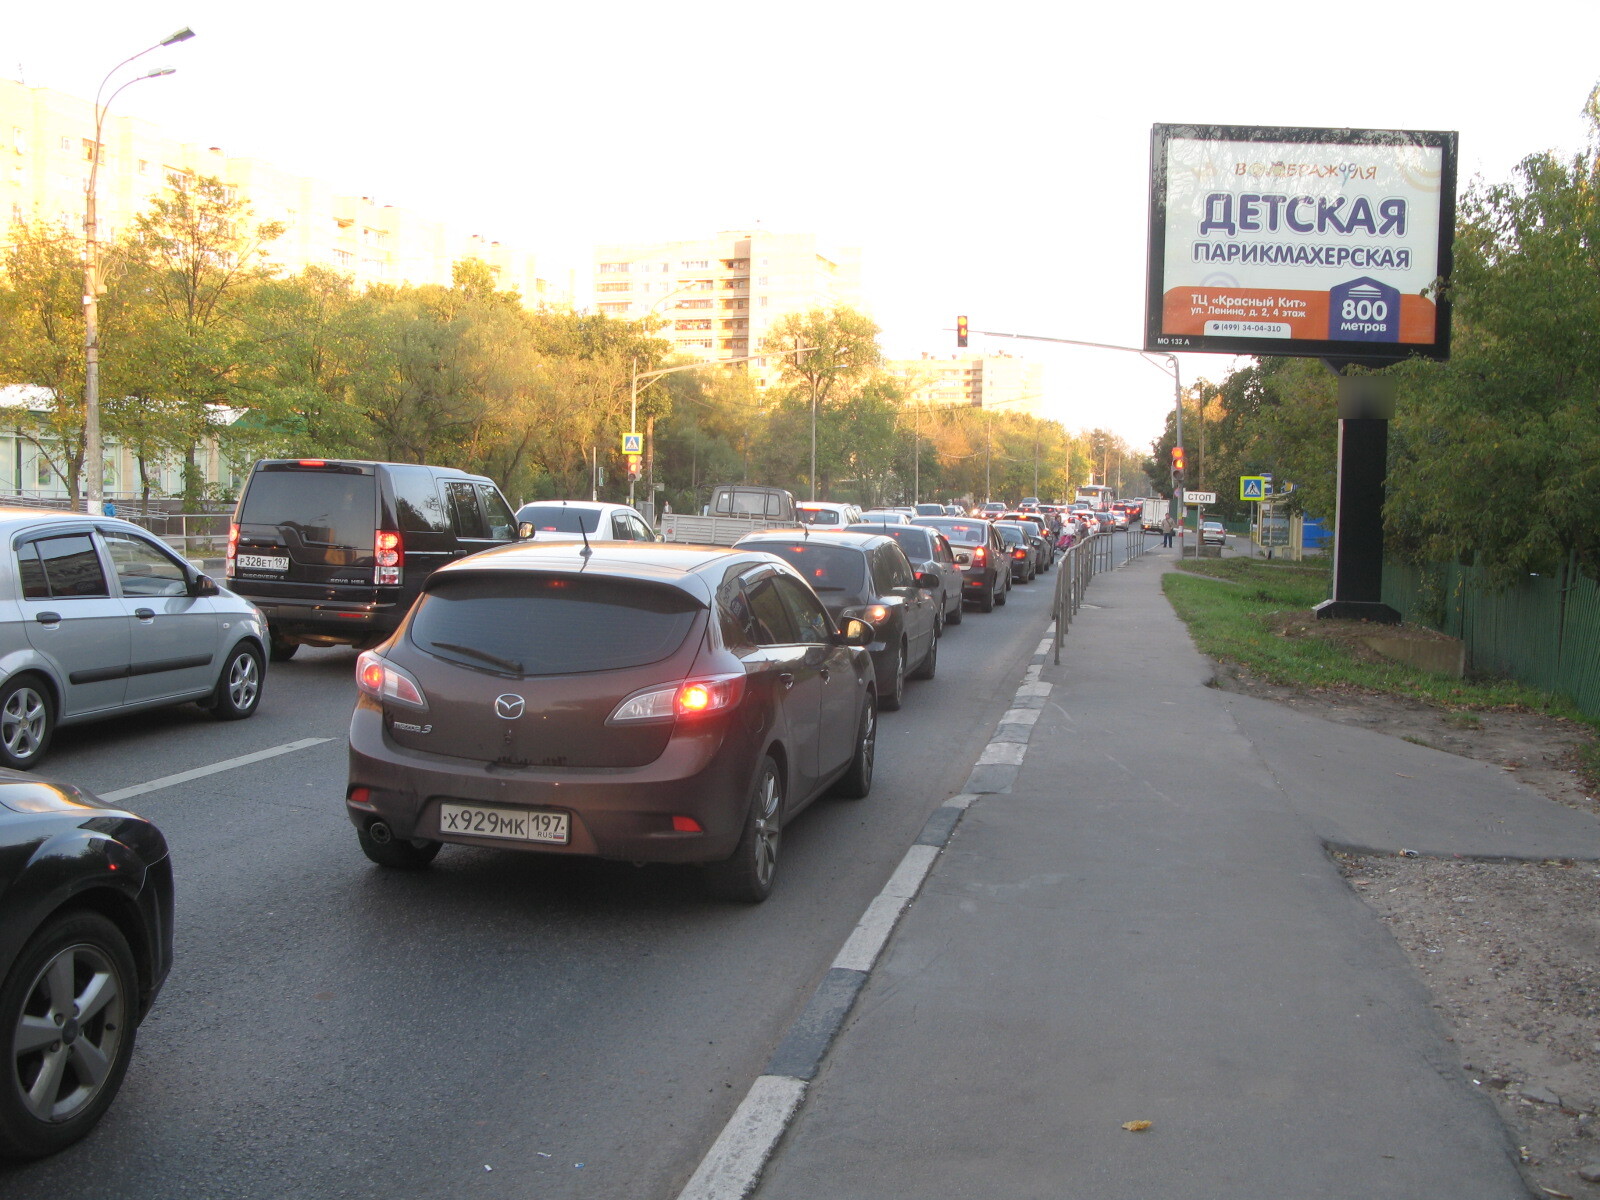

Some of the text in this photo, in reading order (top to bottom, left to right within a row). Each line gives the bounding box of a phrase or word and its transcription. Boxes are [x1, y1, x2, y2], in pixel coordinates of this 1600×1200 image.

[1200, 193, 1406, 236] ДЕТСКАЯ
[1194, 242, 1410, 268] ПАРИКМАХЕРСКАЯ
[1191, 294, 1306, 308] ТЦ «Красный Кит»
[1191, 306, 1306, 318] ул. Ленина, д. 2, 4 этаж
[1341, 299, 1388, 321] 800
[1221, 323, 1282, 333] (499) 34-04-310
[1340, 322, 1387, 334] метров
[1187, 493, 1212, 502] СТОП
[421, 724, 433, 734] 3
[531, 814, 562, 832] 197
[537, 831, 553, 839] RUS
